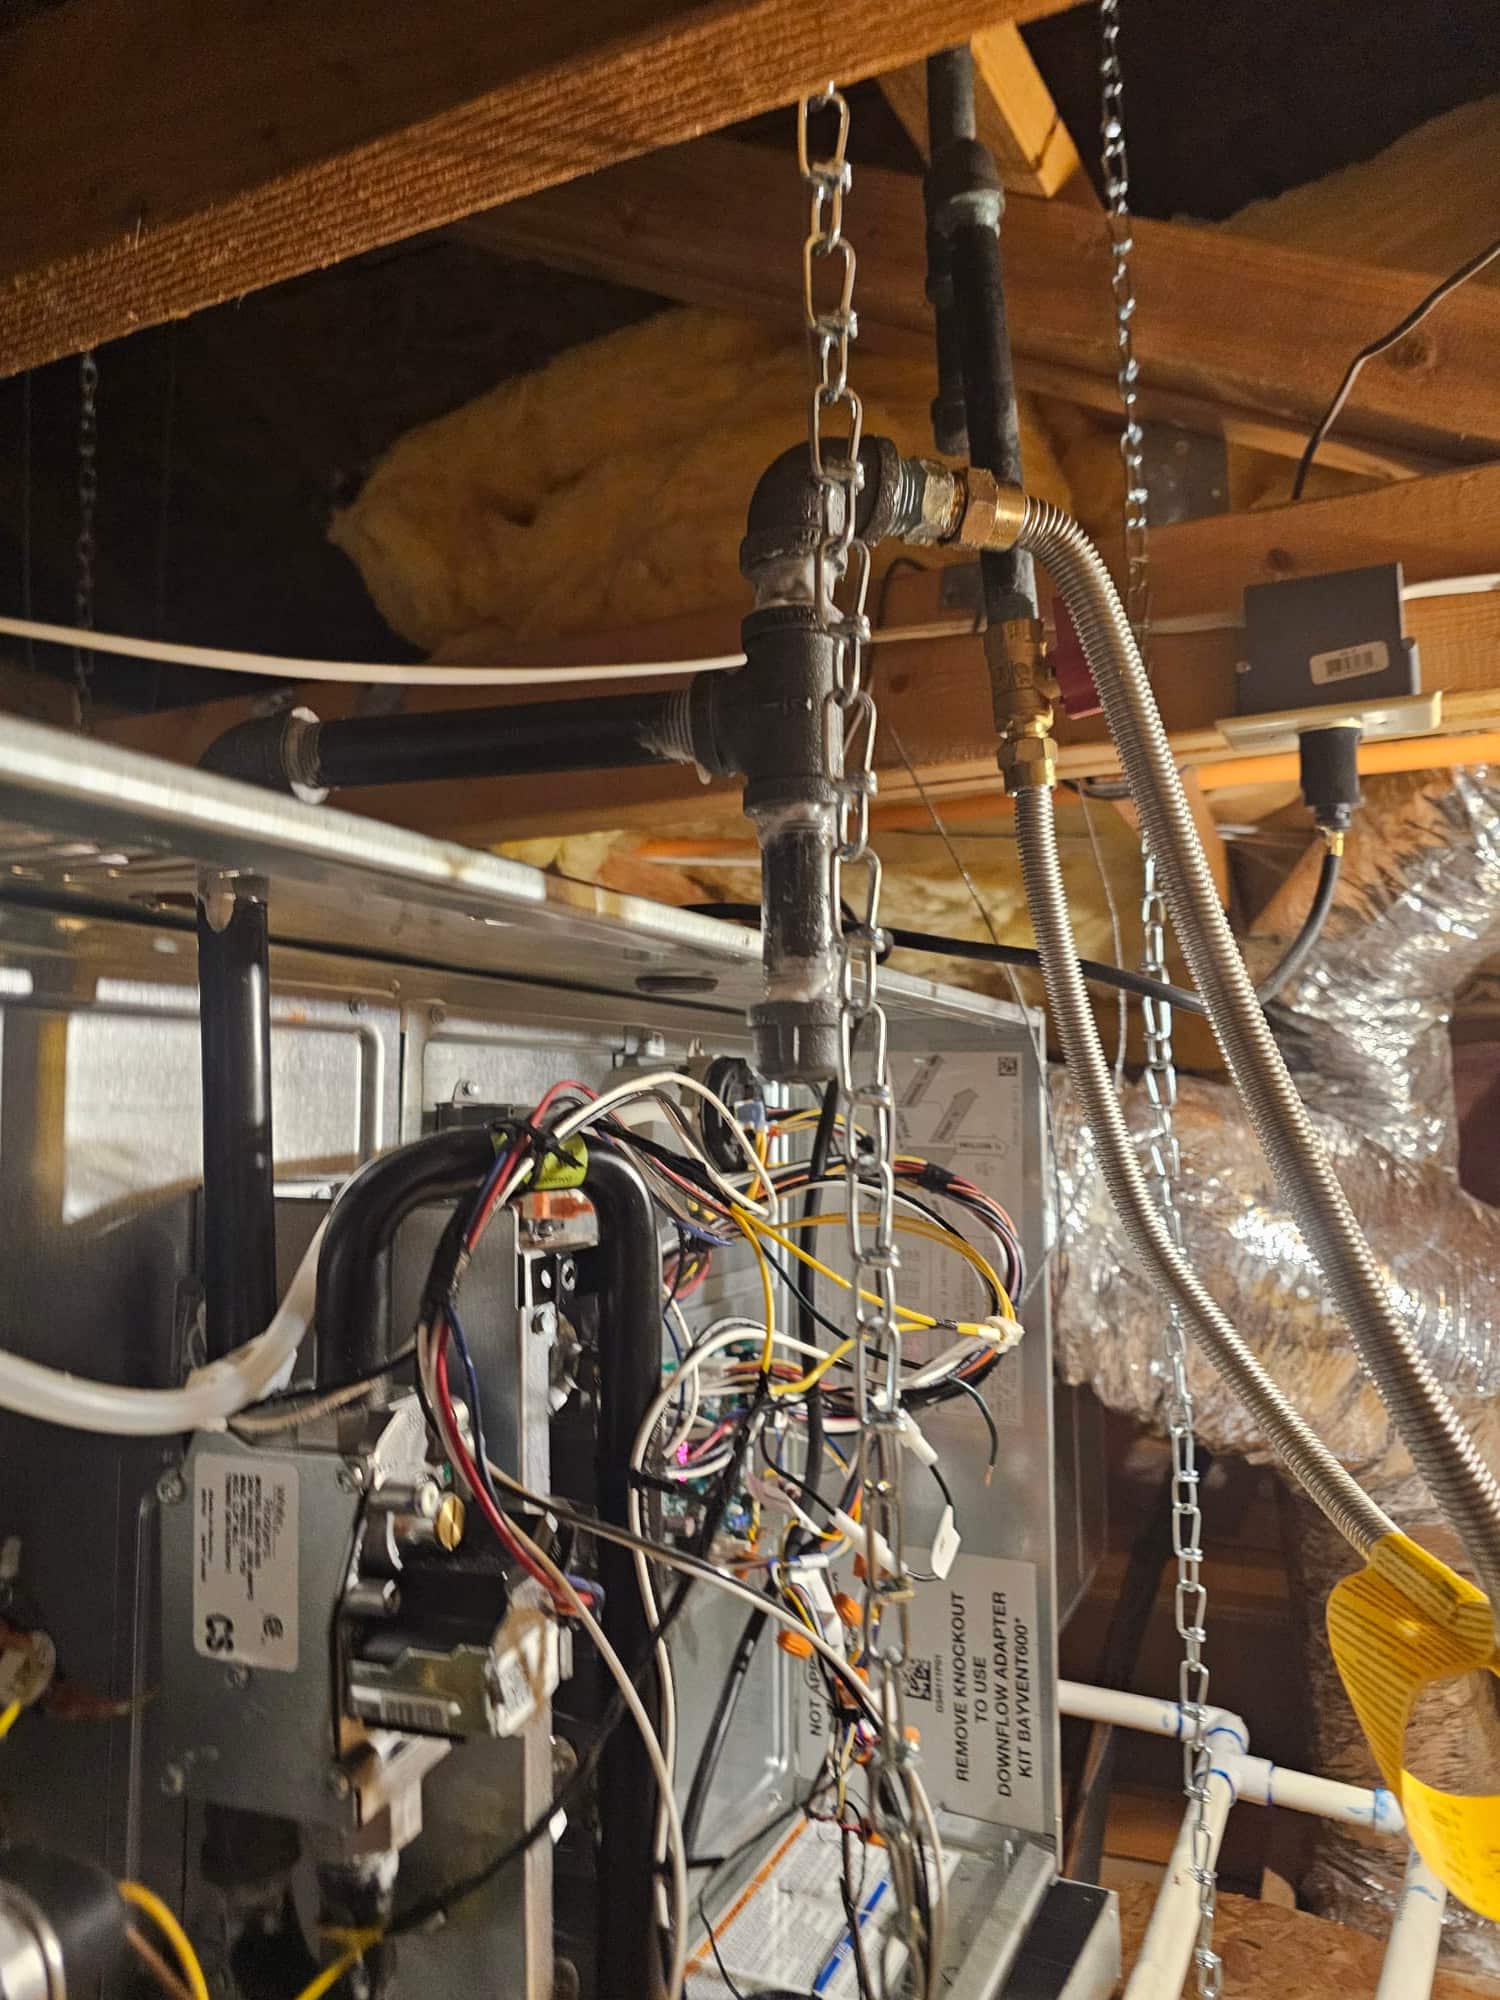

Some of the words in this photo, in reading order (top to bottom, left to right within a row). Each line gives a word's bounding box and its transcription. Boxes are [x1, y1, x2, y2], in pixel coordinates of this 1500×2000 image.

[950, 1592, 968, 1698] KNOCKOUT
[992, 1592, 1008, 1680] ADAPTER
[972, 1656, 987, 1694] USE
[808, 1699, 823, 1737] NOT
[974, 1698, 988, 1724] TO
[995, 1683, 1013, 1797] DOWNFLOW
[952, 1703, 970, 1782] REMOVE
[1017, 1747, 1033, 1779] KIT
